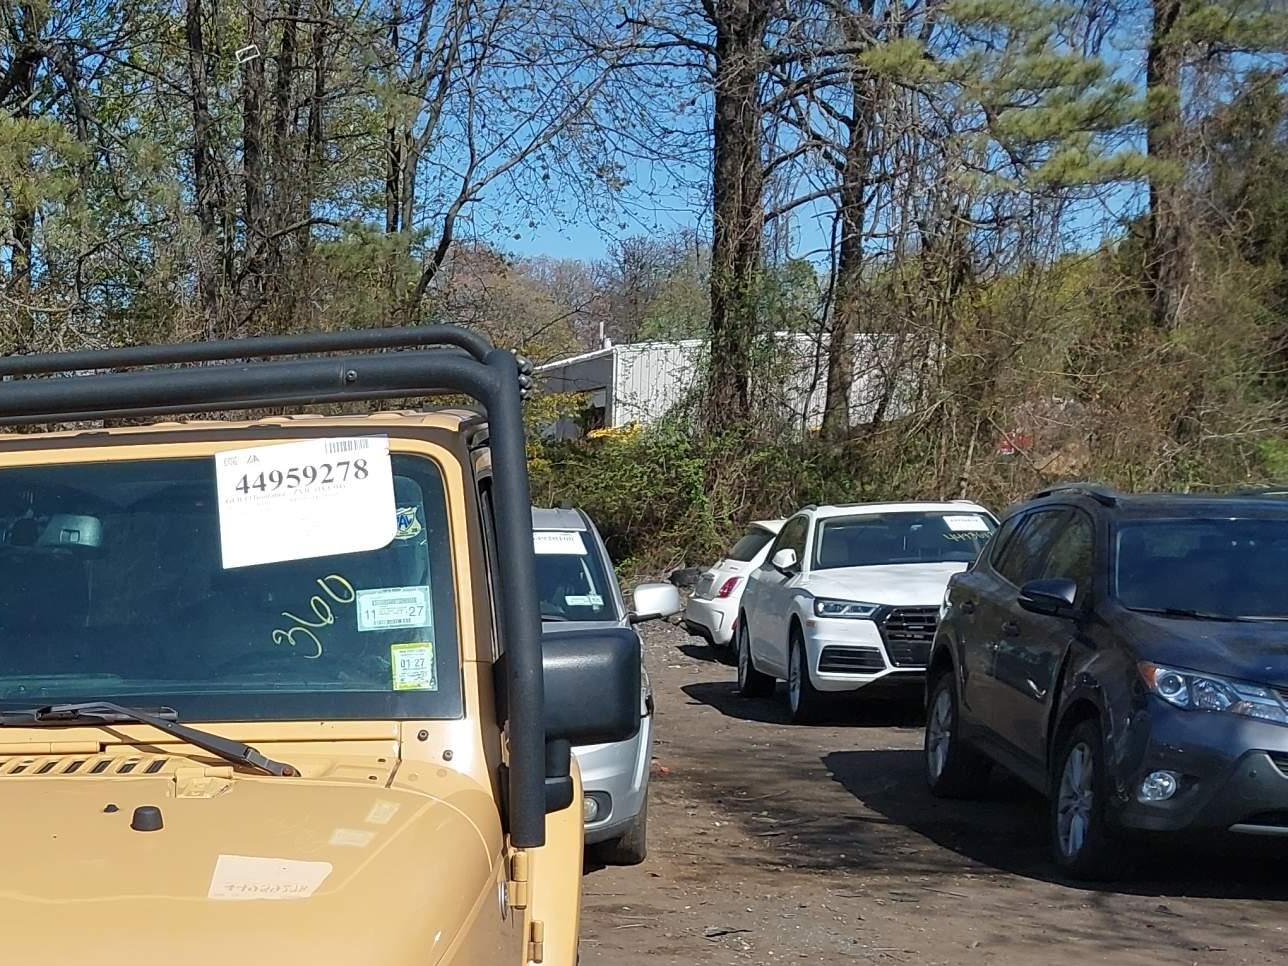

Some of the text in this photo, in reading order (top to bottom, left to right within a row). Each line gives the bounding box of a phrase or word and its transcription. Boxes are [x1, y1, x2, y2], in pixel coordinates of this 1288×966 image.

[235, 458, 369, 494] 44959278
[272, 574, 355, 659] 360
[408, 605, 425, 617] 27
[415, 657, 425, 667] 27
